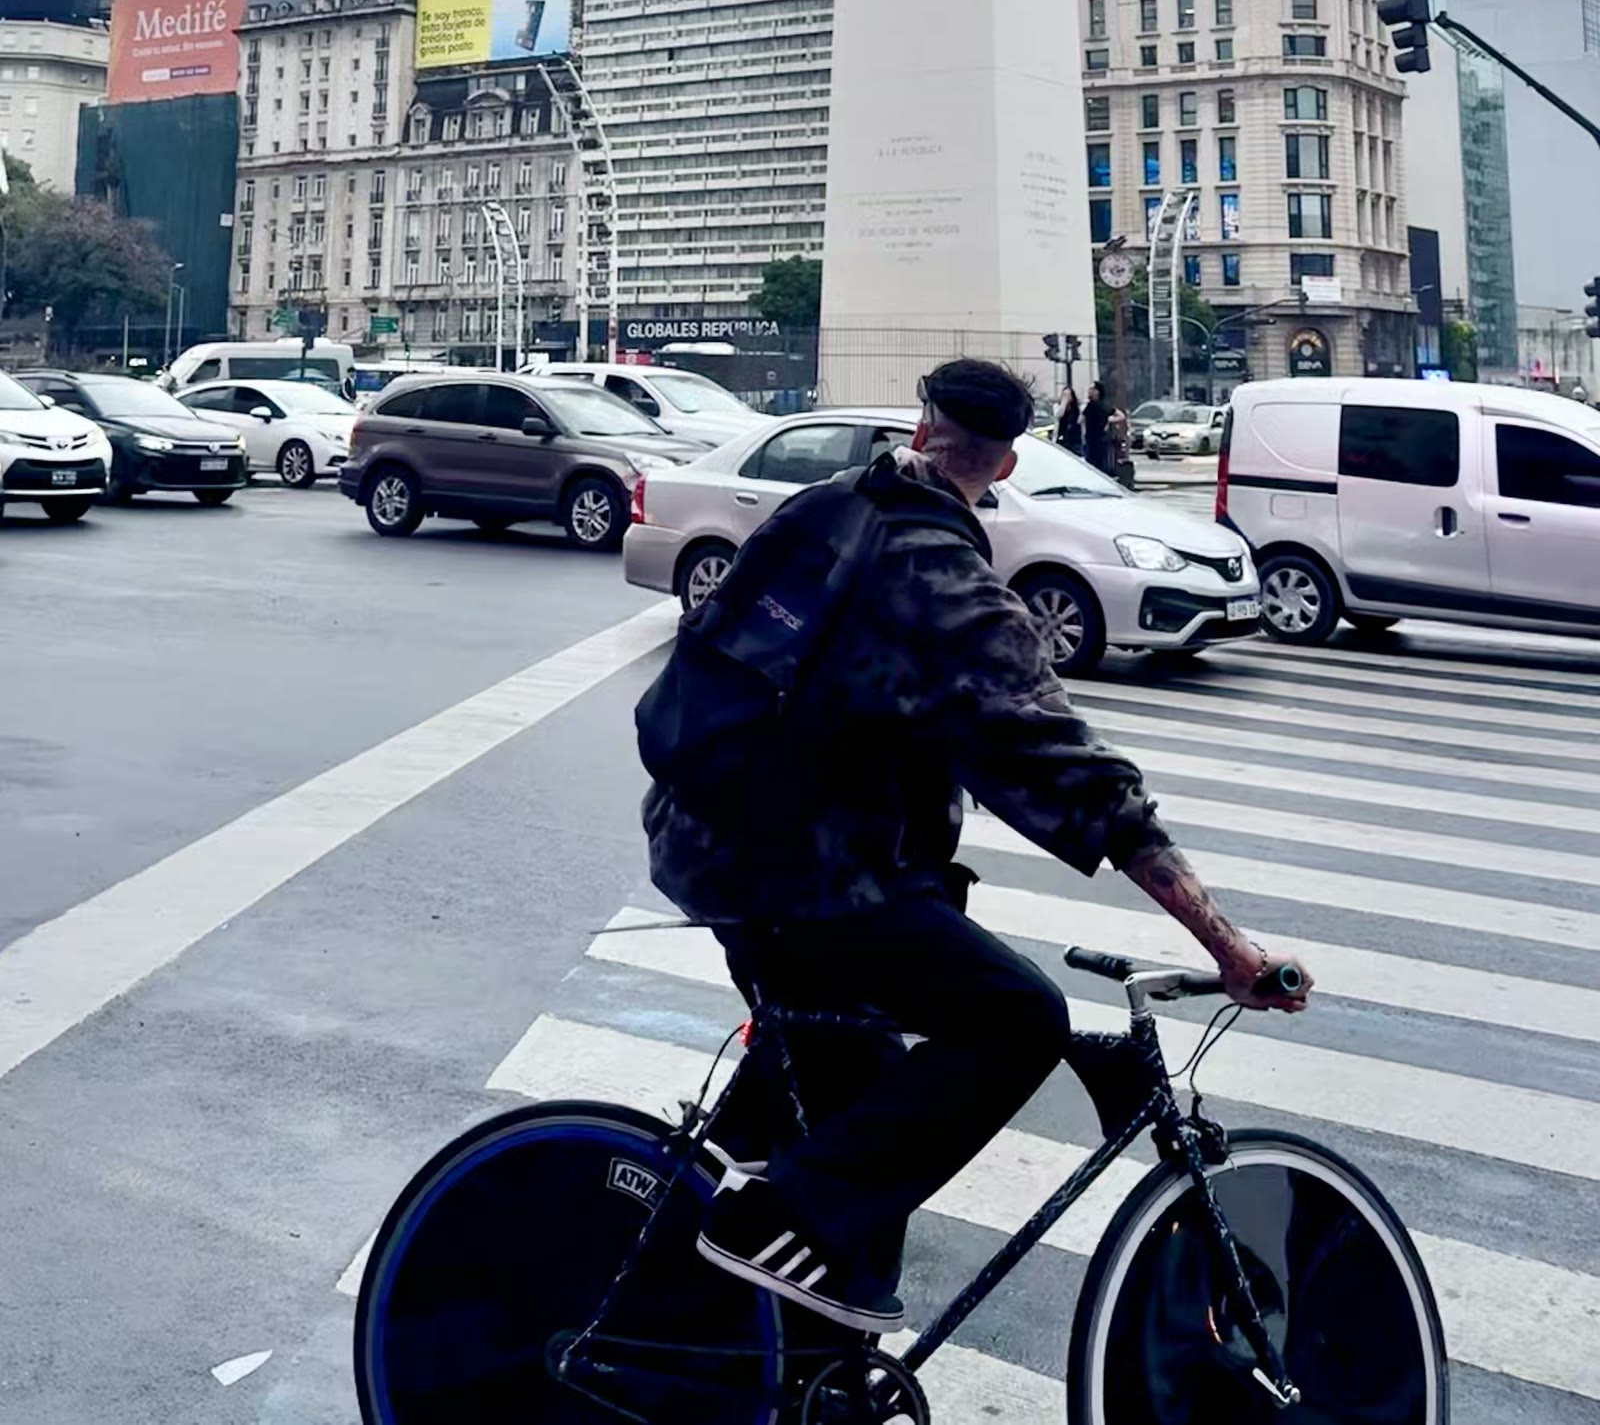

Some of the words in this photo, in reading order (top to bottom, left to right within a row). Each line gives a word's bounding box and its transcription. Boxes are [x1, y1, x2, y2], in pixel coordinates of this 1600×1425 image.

[133, 0, 227, 41] Medifé
[422, 11, 431, 21] Te
[434, 12, 451, 21] soy
[474, 18, 485, 27] de
[420, 45, 446, 58] gratis
[627, 322, 699, 338] GLOBALES
[616, 1167, 653, 1195] ATW
